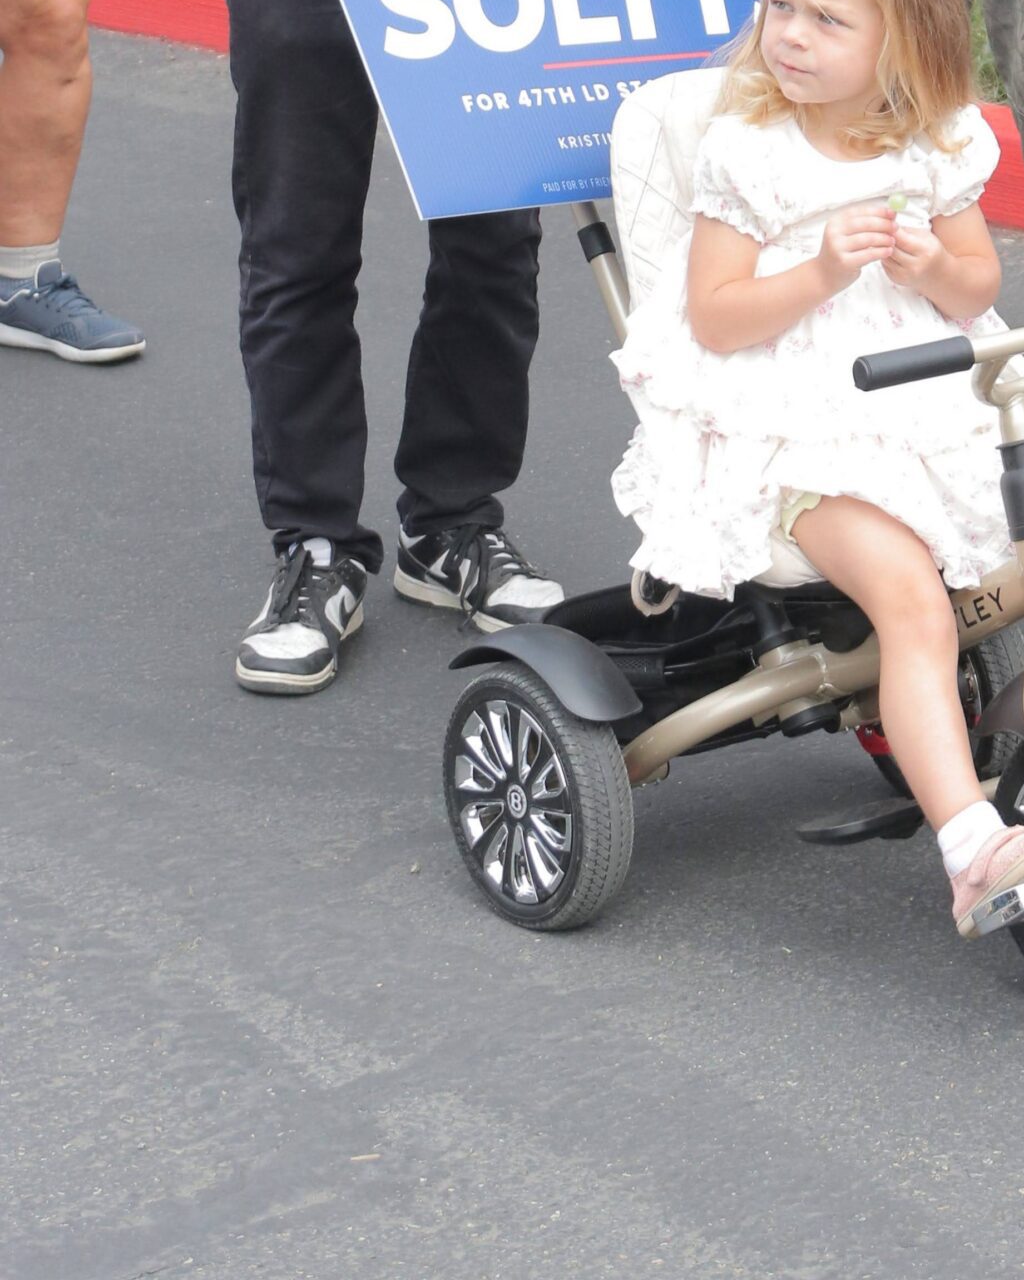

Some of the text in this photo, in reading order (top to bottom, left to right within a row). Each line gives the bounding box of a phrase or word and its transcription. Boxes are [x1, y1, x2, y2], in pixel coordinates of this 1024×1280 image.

[461, 91, 511, 113] FOR
[518, 85, 577, 108] 47TH
[581, 82, 611, 103] LD
[542, 181, 561, 193] PAID
[561, 178, 578, 191] FOR
[954, 586, 1003, 633] LEY
